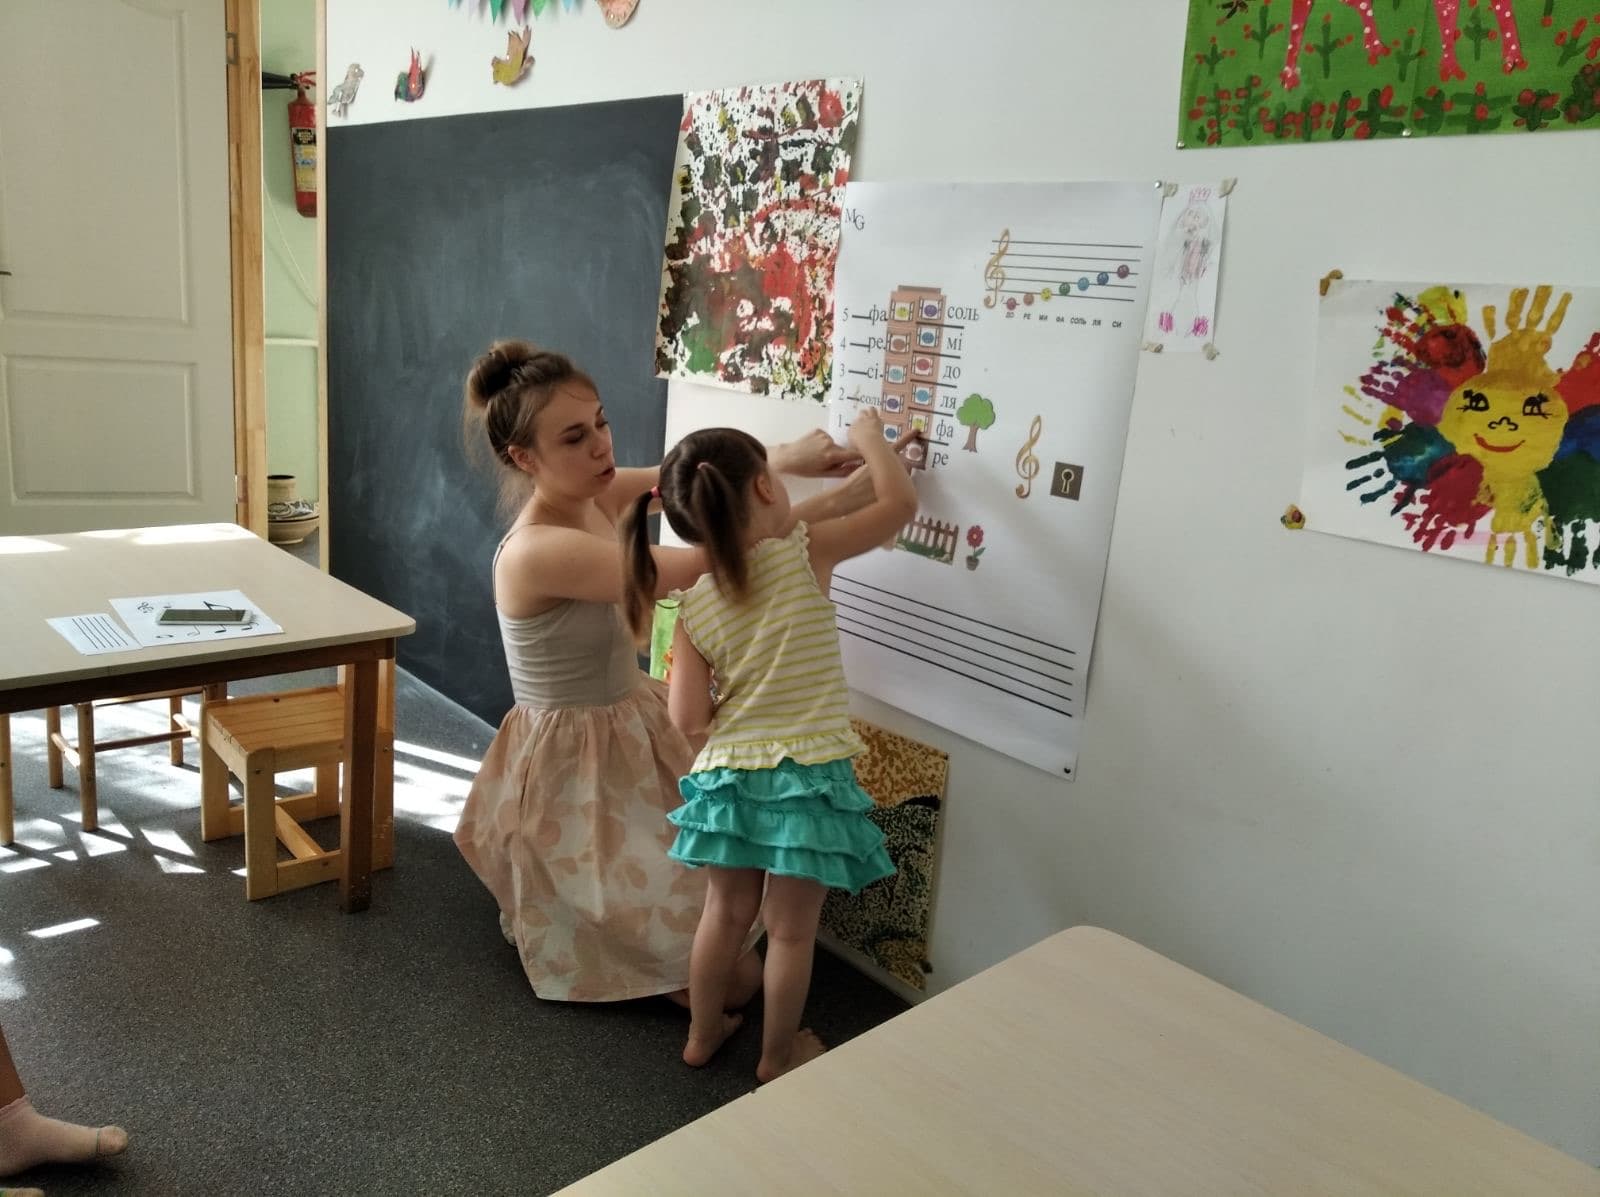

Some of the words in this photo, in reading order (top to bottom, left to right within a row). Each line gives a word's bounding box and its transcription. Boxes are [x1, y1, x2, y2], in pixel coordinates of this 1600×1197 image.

[842, 307, 849, 322] 5
[869, 304, 887, 326] фа
[947, 304, 980, 321] соль
[1070, 317, 1087, 325] СОЛЬ
[1112, 320, 1122, 328] СИ
[840, 336, 847, 350] 4
[868, 335, 884, 353] ре
[946, 332, 962, 351] мі
[839, 363, 846, 377] 3
[942, 364, 961, 380] до
[838, 387, 845, 401] 2
[940, 396, 957, 410] ля
[935, 418, 954, 440] фа
[931, 451, 949, 468] ре
